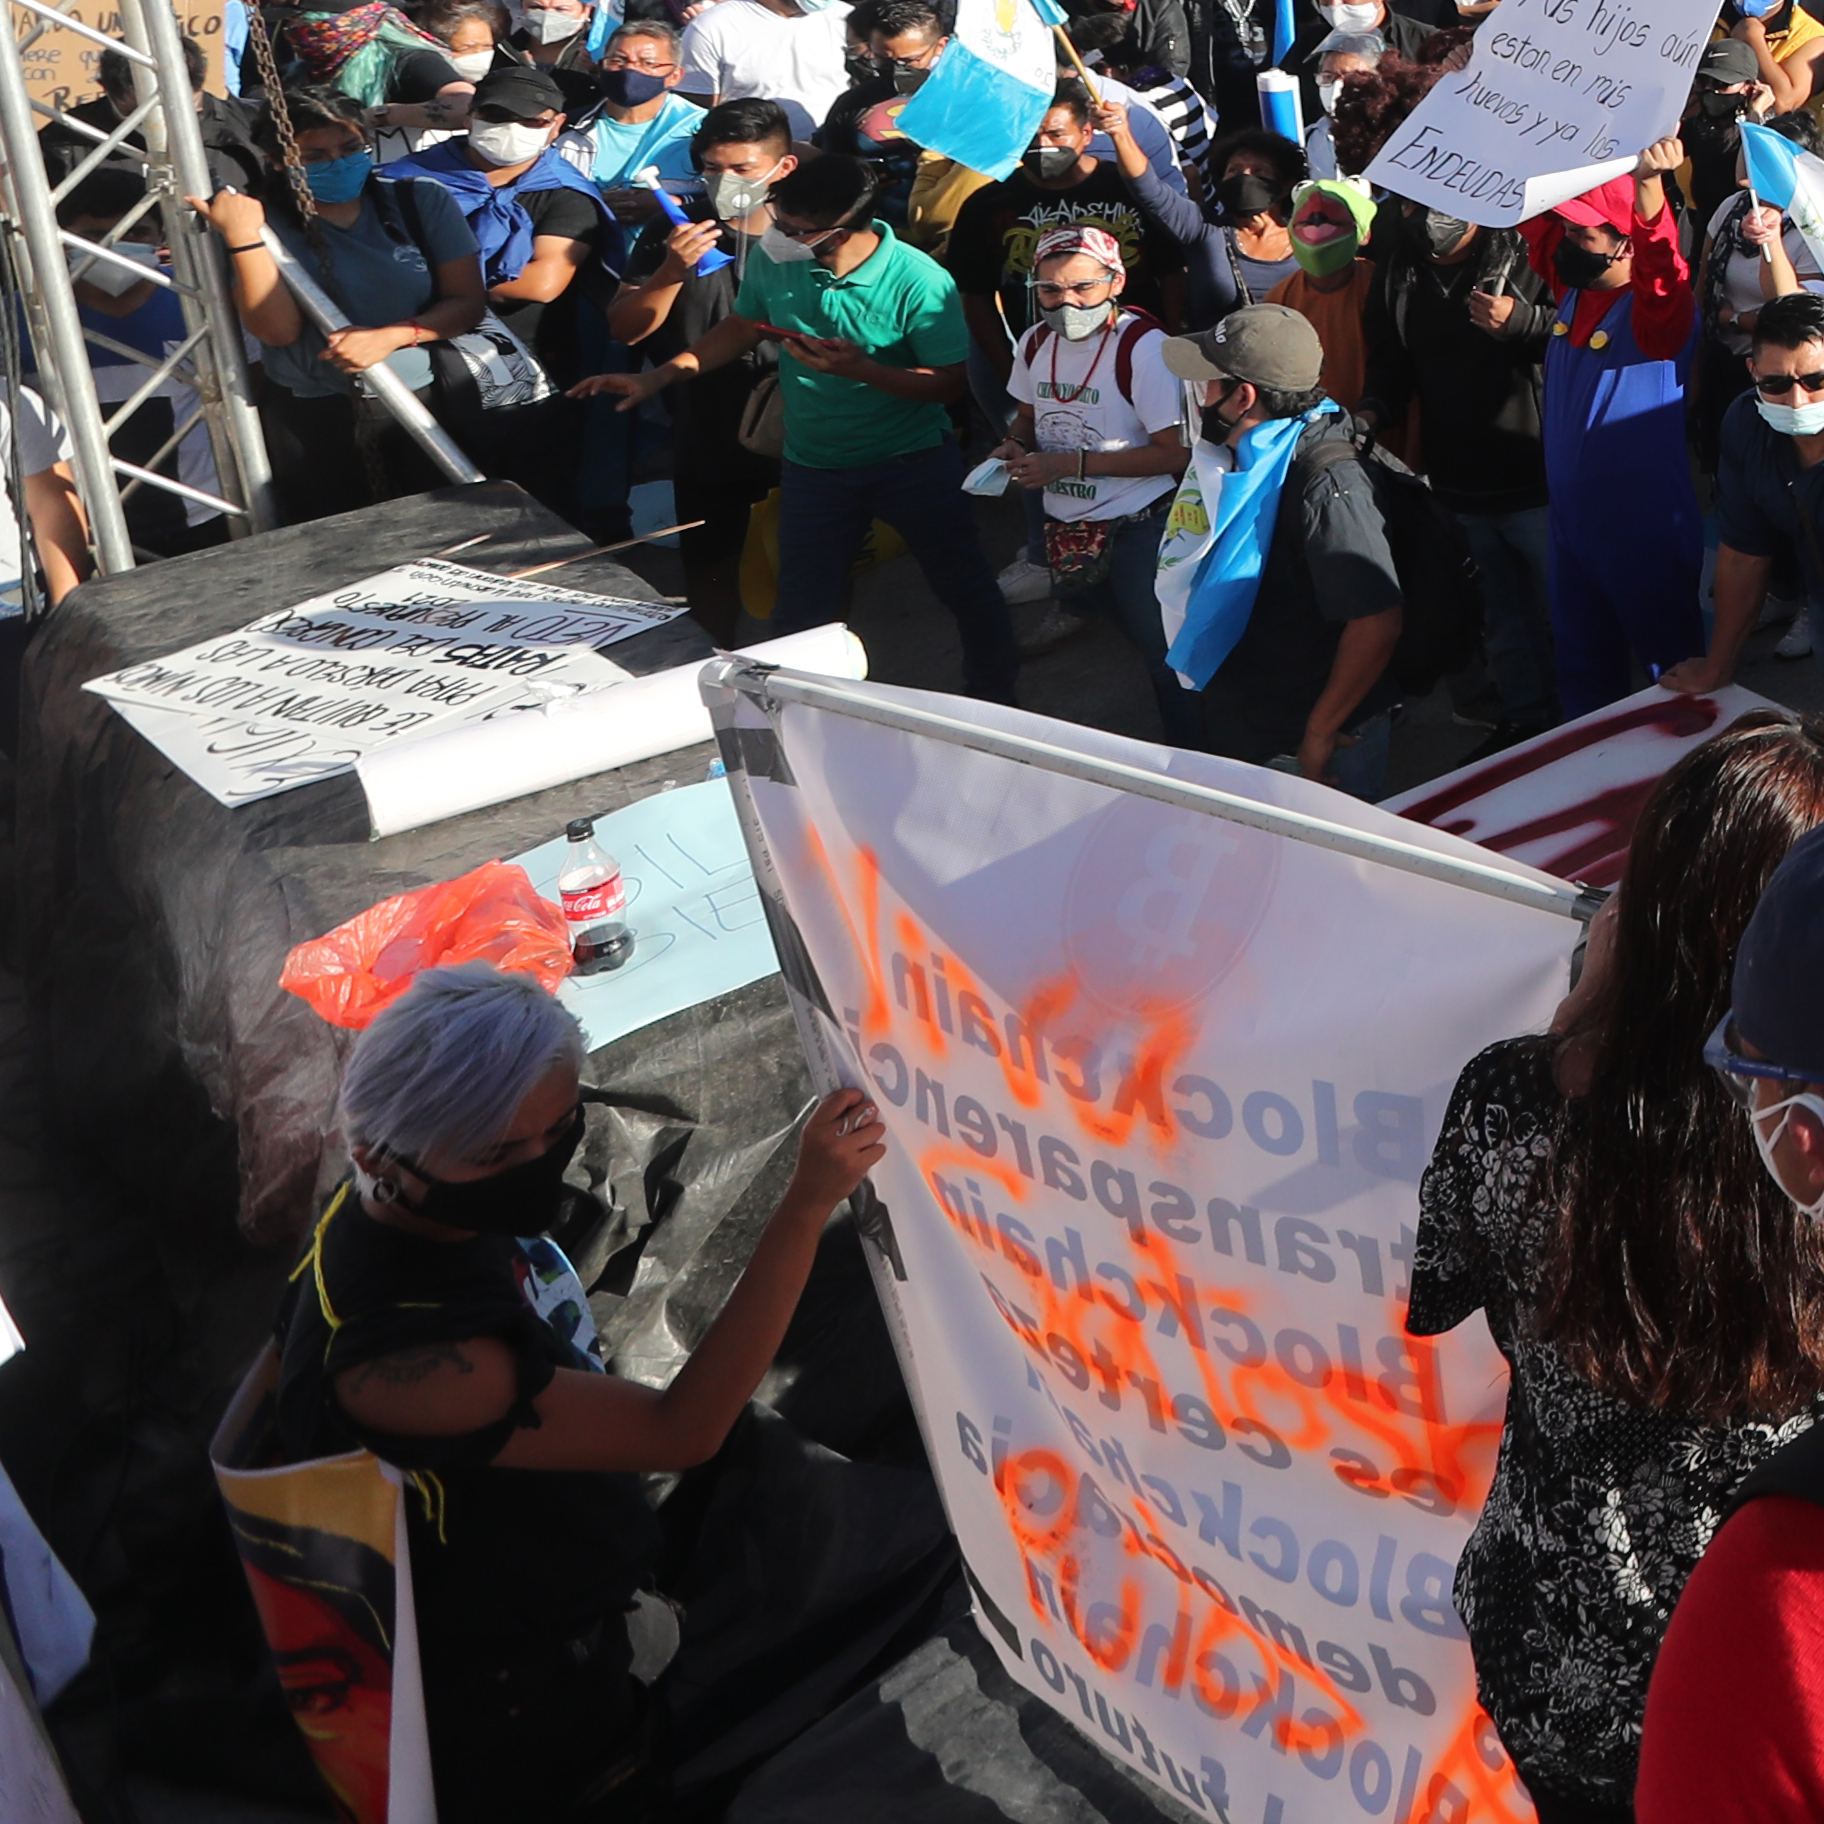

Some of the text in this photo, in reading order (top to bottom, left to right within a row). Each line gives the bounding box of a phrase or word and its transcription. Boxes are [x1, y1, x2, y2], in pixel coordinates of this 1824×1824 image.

[1659, 28, 1700, 70] aún
[1490, 31, 1633, 111] estan en mis
[1455, 70, 1621, 161] huevos y ya los
[333, 592, 629, 649] VETO AL PRESUPUESTO
[402, 592, 468, 610] 2021
[243, 611, 394, 654] CONGRESO
[207, 640, 273, 666] LAS
[276, 653, 302, 673] A
[433, 639, 566, 678] RATAS
[270, 687, 388, 732] QUITAN
[415, 673, 496, 708] PARA
[390, 707, 435, 737] LE
